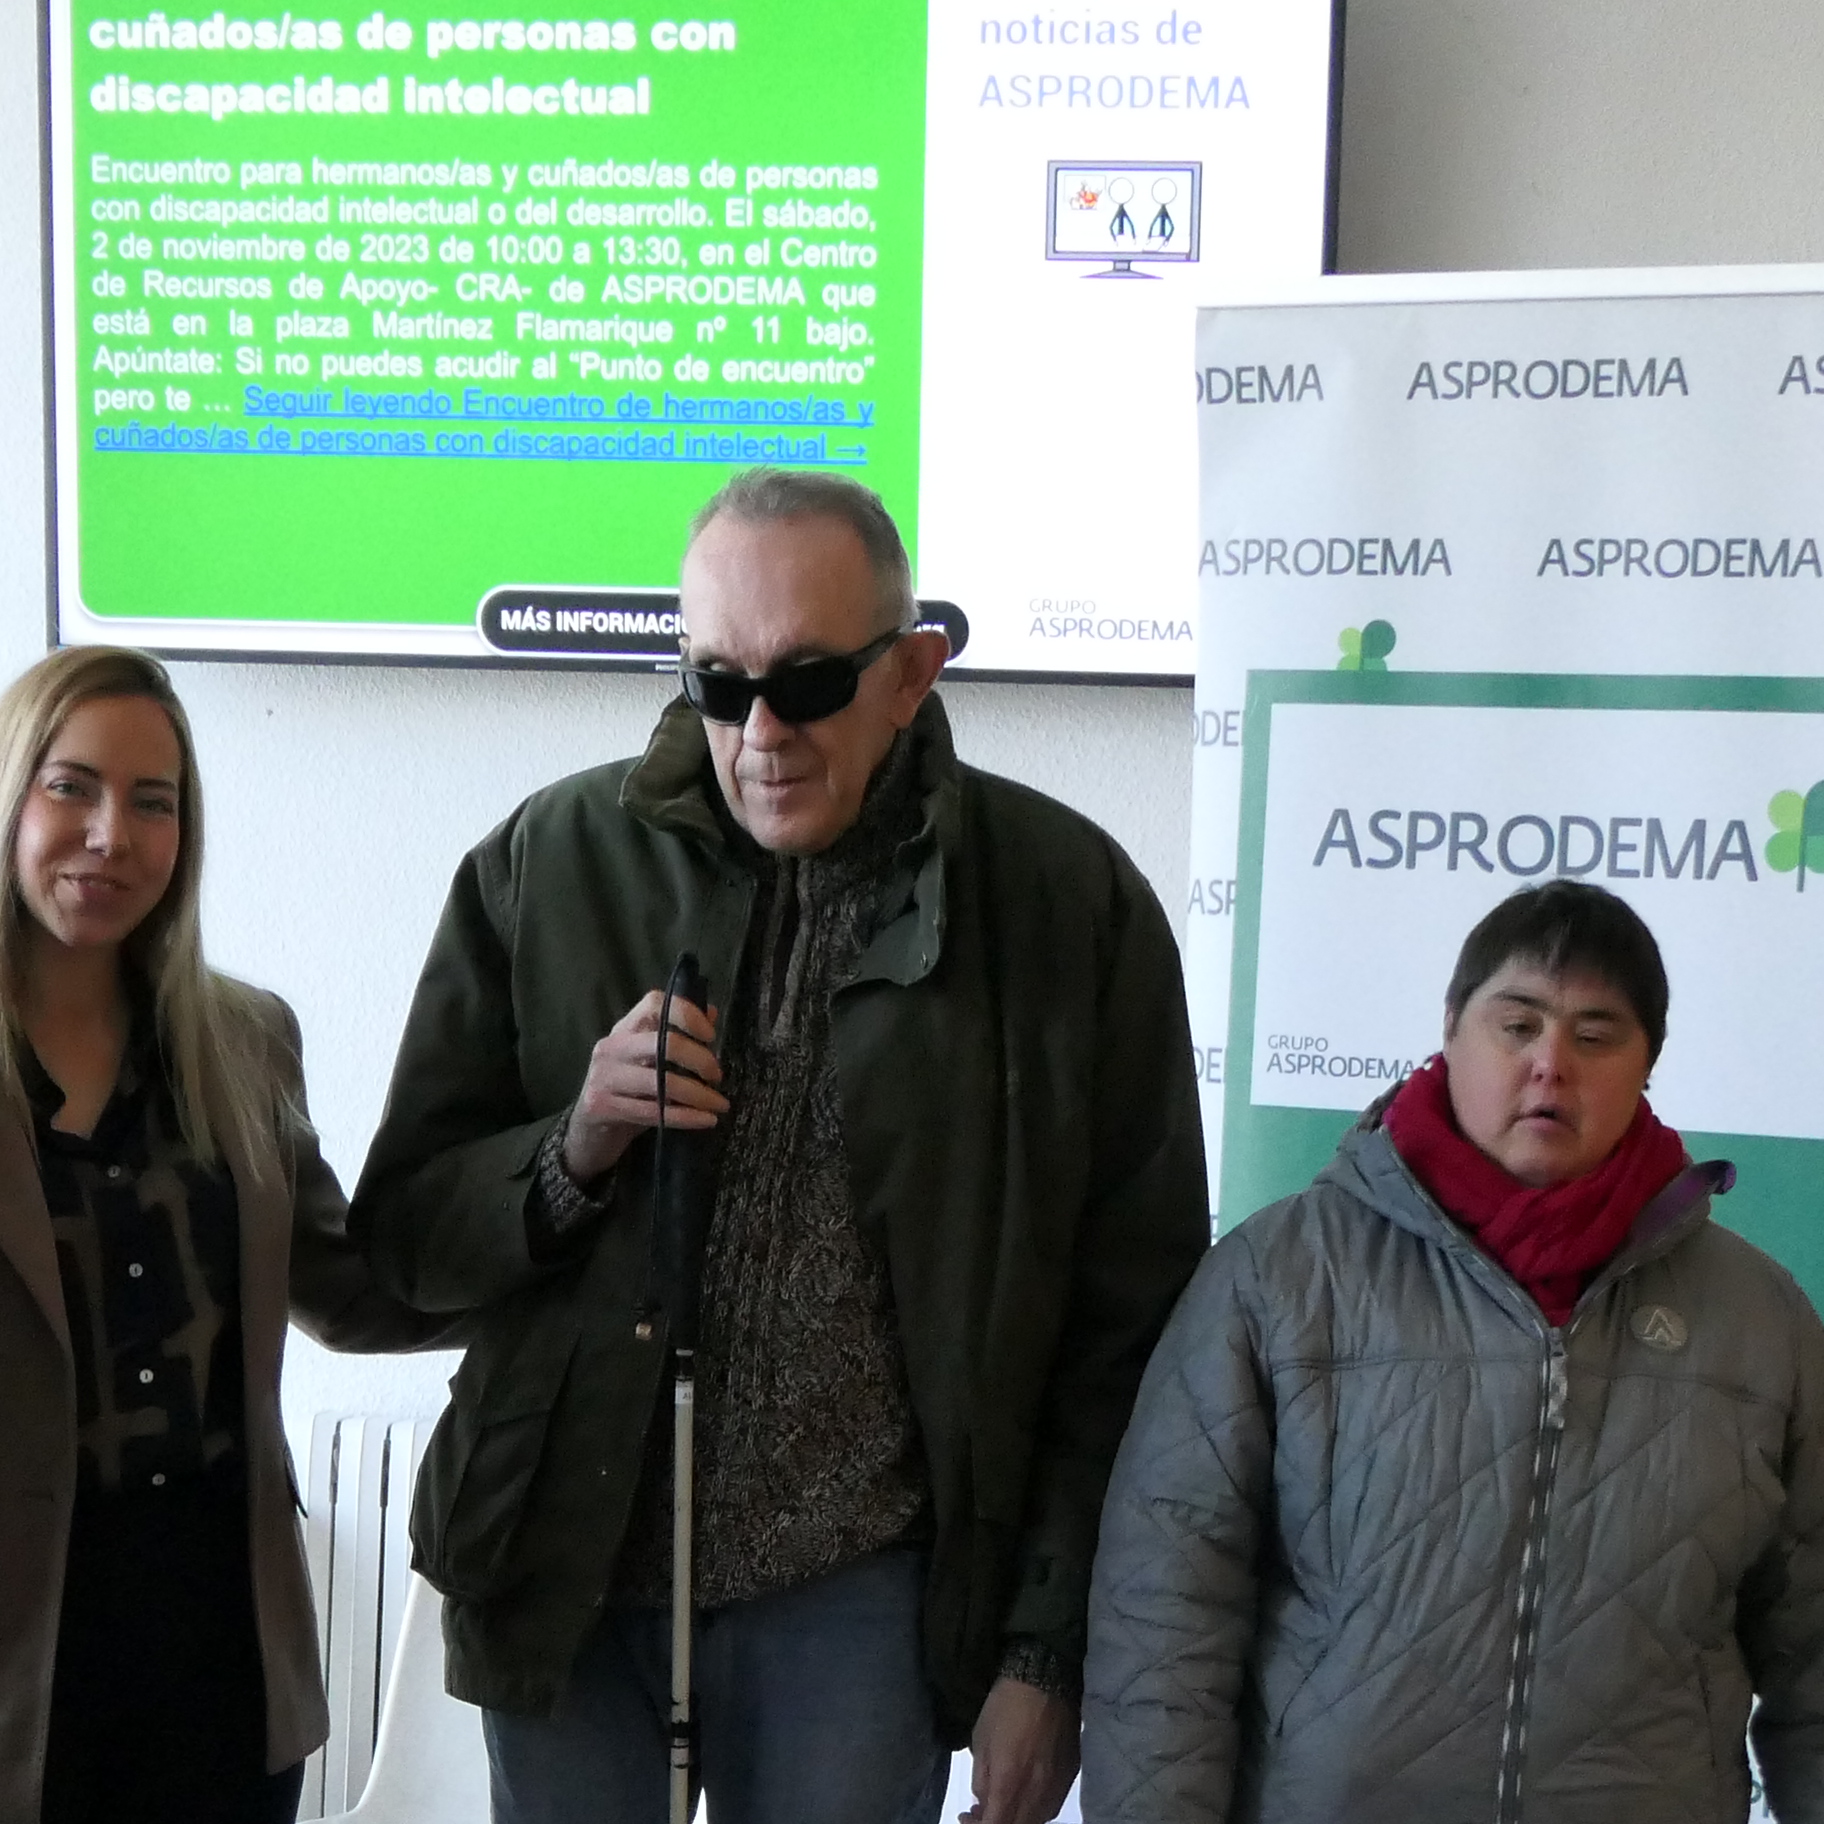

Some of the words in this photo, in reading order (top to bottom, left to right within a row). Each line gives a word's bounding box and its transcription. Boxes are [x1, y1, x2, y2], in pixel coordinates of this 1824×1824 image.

[89, 12, 342, 50] cuñados/as
[357, 12, 412, 50] de
[427, 19, 637, 58] personas
[651, 20, 736, 51] con
[980, 9, 1140, 45] noticias
[1156, 9, 1203, 45] de
[89, 74, 389, 121] discapacidad
[404, 75, 650, 115] intelectual
[979, 75, 1250, 109] ASPRODEMA
[91, 154, 230, 184] Encuentro
[241, 160, 302, 189] para
[312, 155, 492, 187] hermanos/as
[502, 165, 518, 193] y
[528, 158, 690, 188] cuñados/as
[700, 160, 736, 188] de
[746, 165, 878, 194] personas
[91, 198, 140, 221] con
[150, 194, 329, 228] discapacidad
[339, 196, 478, 224] intelectual
[489, 204, 505, 225] o
[516, 198, 557, 225] del
[566, 198, 714, 227] desarrollo.
[725, 199, 753, 227] El
[763, 199, 877, 232] sábado,
[91, 231, 108, 259] 2
[119, 233, 152, 260] de
[163, 231, 306, 261] noviembre
[315, 234, 350, 261] de
[360, 234, 429, 262] 2023
[439, 235, 474, 263] de
[486, 236, 563, 264] 10:00
[573, 243, 591, 264] a
[603, 237, 687, 268] 13:30,
[699, 244, 734, 266] en
[745, 238, 769, 266] el
[781, 238, 877, 267] Centro
[92, 270, 126, 297] de
[143, 269, 272, 299] Recursos
[288, 273, 324, 299] de
[340, 273, 438, 306] Apoyo-
[456, 273, 532, 302] CRA-
[549, 275, 584, 303] de
[602, 275, 806, 305] ASPRODEMA
[823, 284, 877, 312] que
[93, 308, 150, 335] está
[172, 315, 207, 335] en
[229, 310, 252, 336] la
[276, 311, 349, 342] plaza
[373, 311, 493, 340] Martínez
[517, 312, 673, 348] Flamarique
[696, 316, 726, 342] nº
[752, 316, 780, 343] 11
[807, 317, 874, 352] bajo.
[93, 345, 222, 377] Apúntate:
[236, 346, 262, 374] Si
[276, 353, 309, 375] no
[321, 349, 423, 381] puedes
[435, 351, 520, 377] acudir
[532, 353, 557, 379] al
[674, 354, 709, 381] de
[1407, 358, 1689, 400] ASPRODEMA
[94, 390, 154, 415] pero
[165, 387, 191, 411] te
[244, 384, 333, 419] Seguir
[344, 387, 451, 421] leyendo
[464, 388, 603, 418] Encuentro
[617, 392, 651, 418] de
[664, 392, 845, 421] hermanos/as
[858, 401, 874, 428] y
[94, 421, 248, 449] cuñados/as
[258, 423, 291, 450] de
[301, 429, 426, 456] personas
[435, 432, 483, 453] con
[494, 428, 675, 461] discapacidad
[685, 431, 826, 459] intelectual
[1199, 538, 1452, 577] ASPRODEMA
[1537, 538, 1822, 578] ASPRODEMA
[501, 606, 551, 631] MÁS
[1029, 599, 1096, 614] GRUPO
[1029, 617, 1193, 641] ASPRODEMA
[1312, 808, 1758, 882] ASPRODEMA
[1268, 1034, 1329, 1052] GRUPO
[1267, 1053, 1415, 1081] ASPRODEMA
